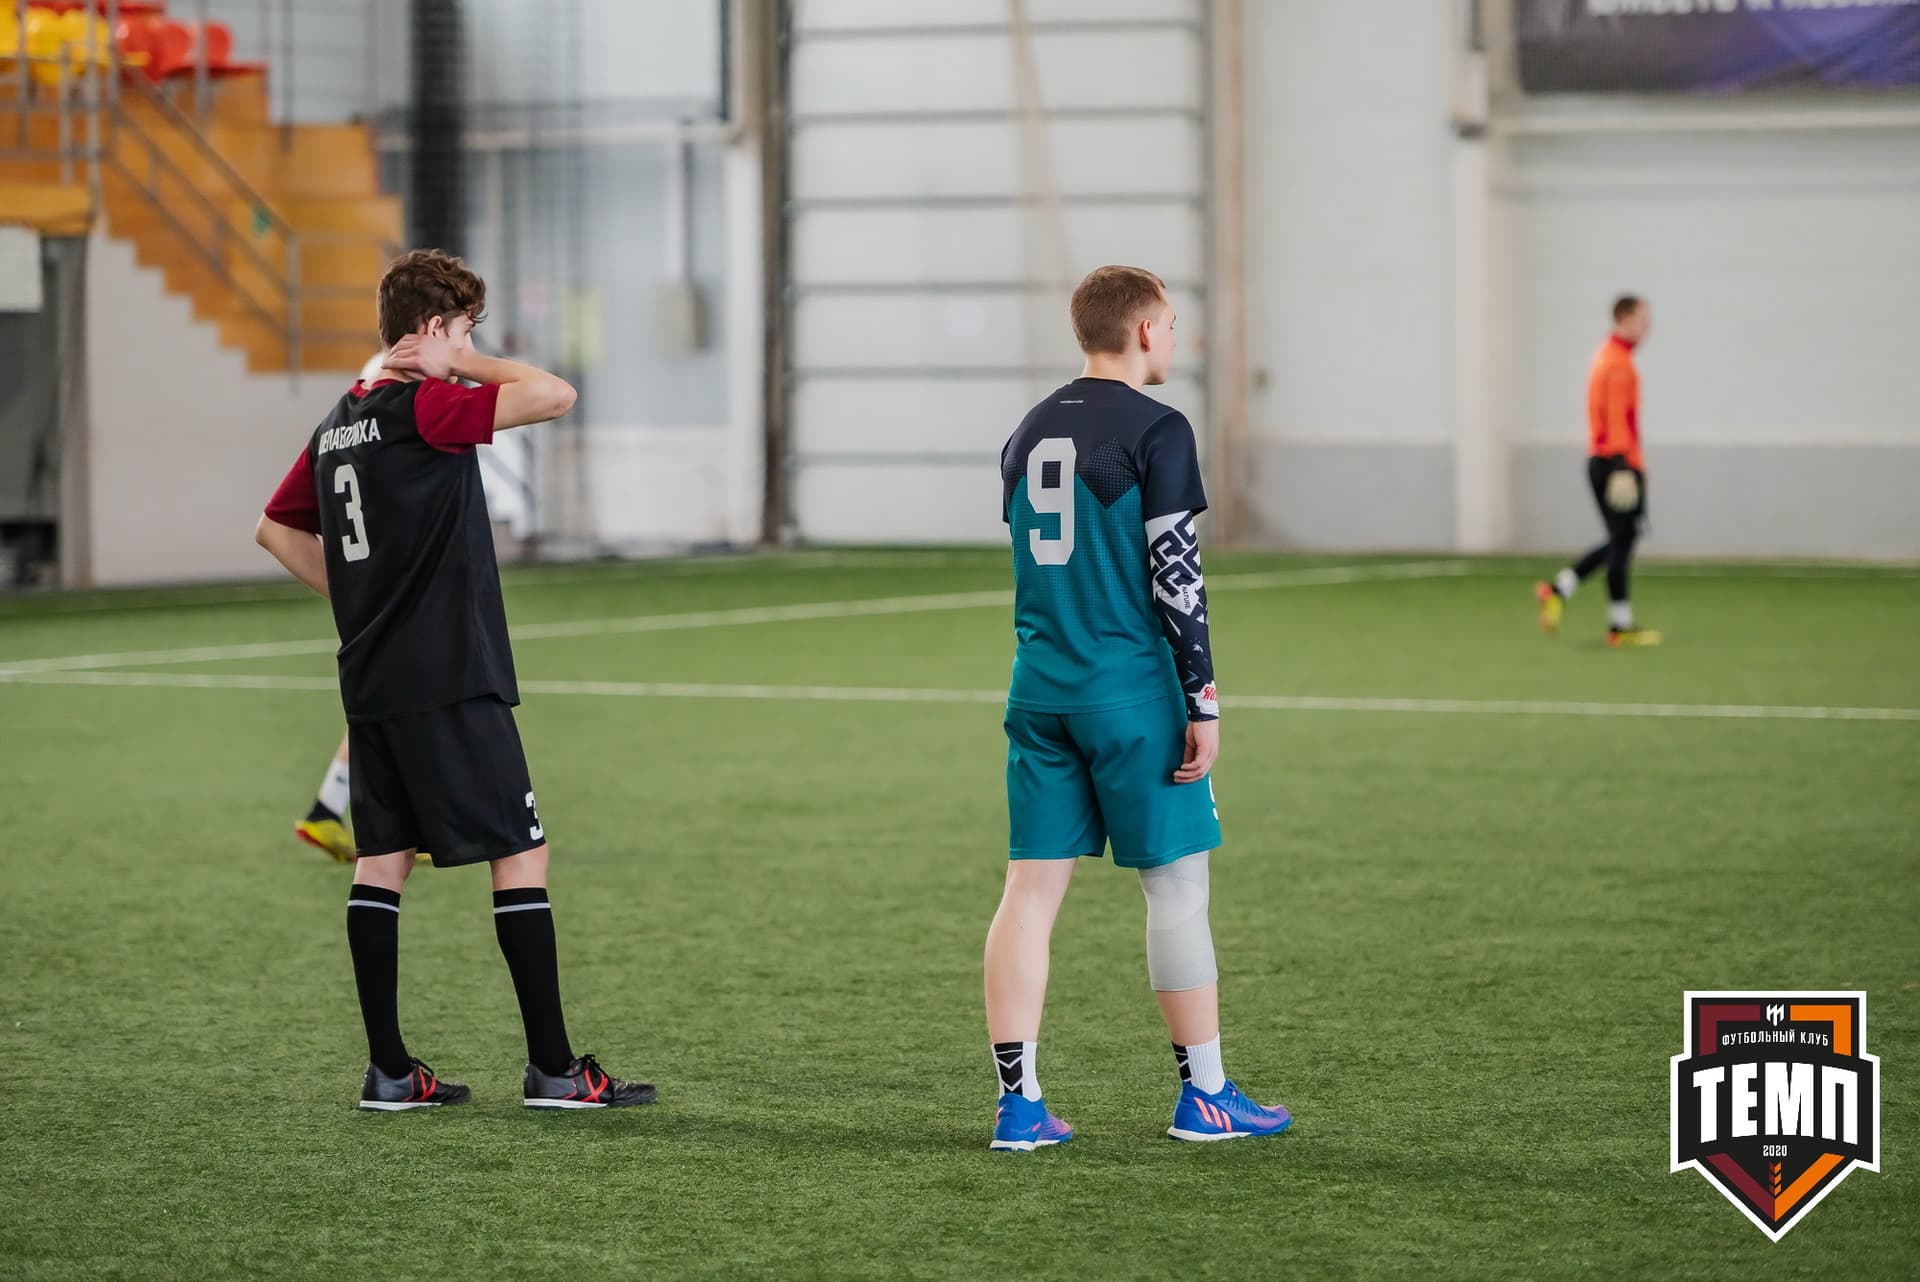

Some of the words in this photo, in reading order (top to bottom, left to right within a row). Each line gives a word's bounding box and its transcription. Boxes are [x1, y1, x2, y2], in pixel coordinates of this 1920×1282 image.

[334, 464, 370, 562] 3
[1027, 437, 1077, 566] 9
[1182, 586, 1191, 609] NATURE
